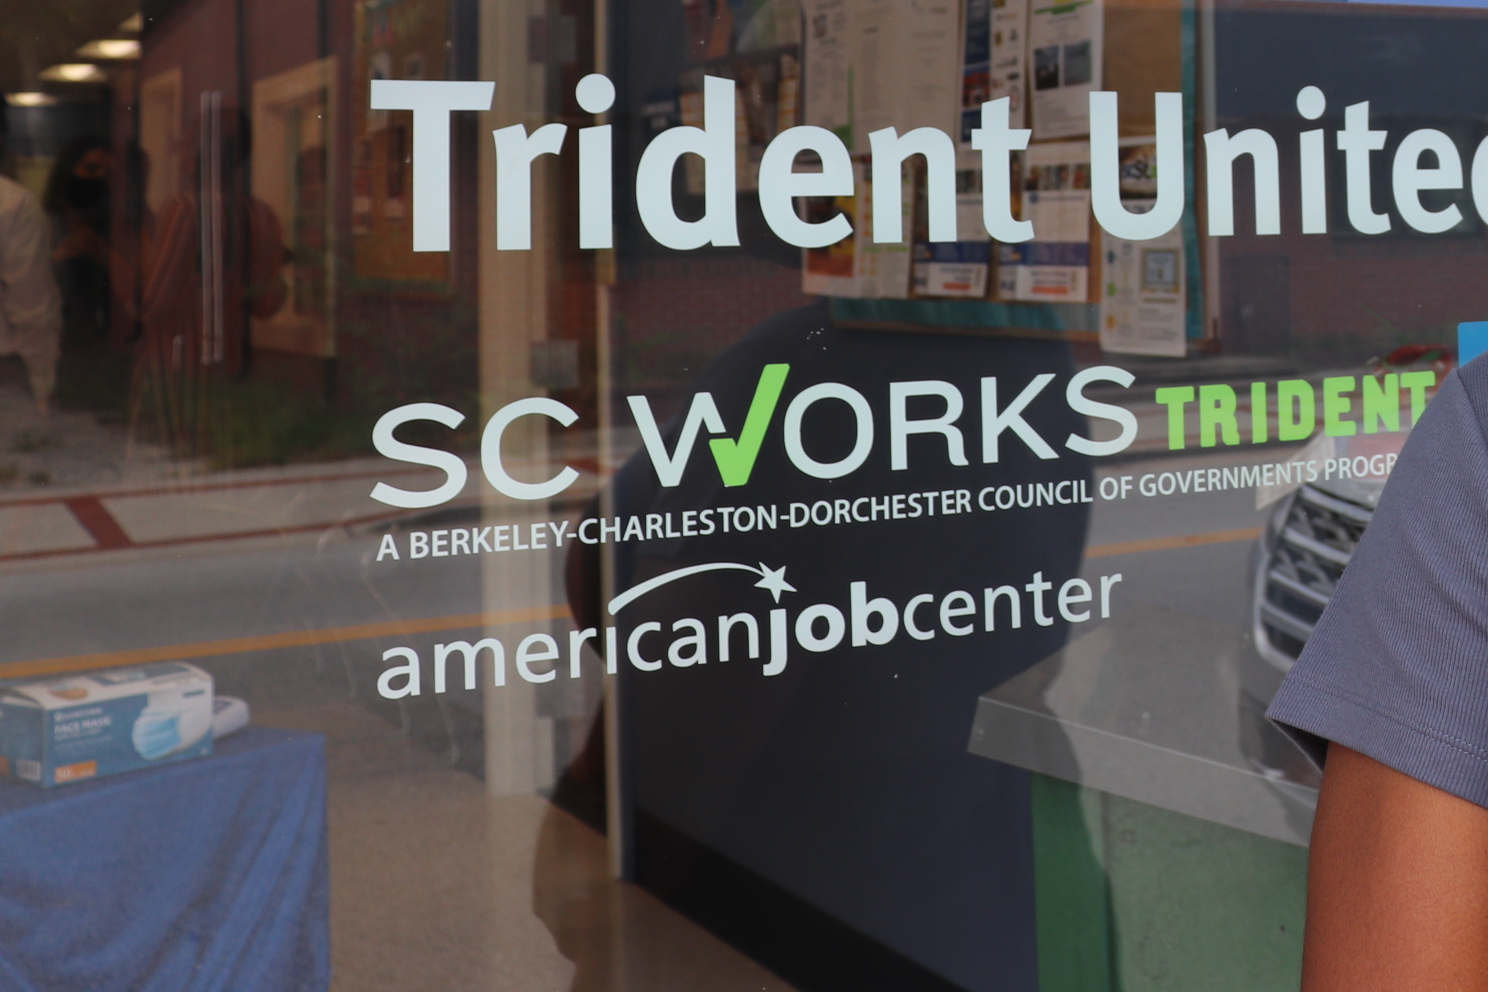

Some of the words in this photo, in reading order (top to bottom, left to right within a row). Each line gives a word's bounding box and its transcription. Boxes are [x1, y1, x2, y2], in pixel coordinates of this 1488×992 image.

[370, 72, 1035, 252] Trident
[369, 396, 580, 508] SC
[626, 362, 1139, 488] WORKS
[1155, 370, 1436, 450] TRIDENT
[376, 534, 400, 561] A
[409, 490, 972, 561] BERKELEY-CHARLESTON-DORCHESTER
[978, 478, 1094, 512] COUNCIL
[1100, 474, 1134, 501] OF
[1139, 460, 1319, 498] GOVERNMENTS
[376, 570, 1123, 700] americanjobcenter
